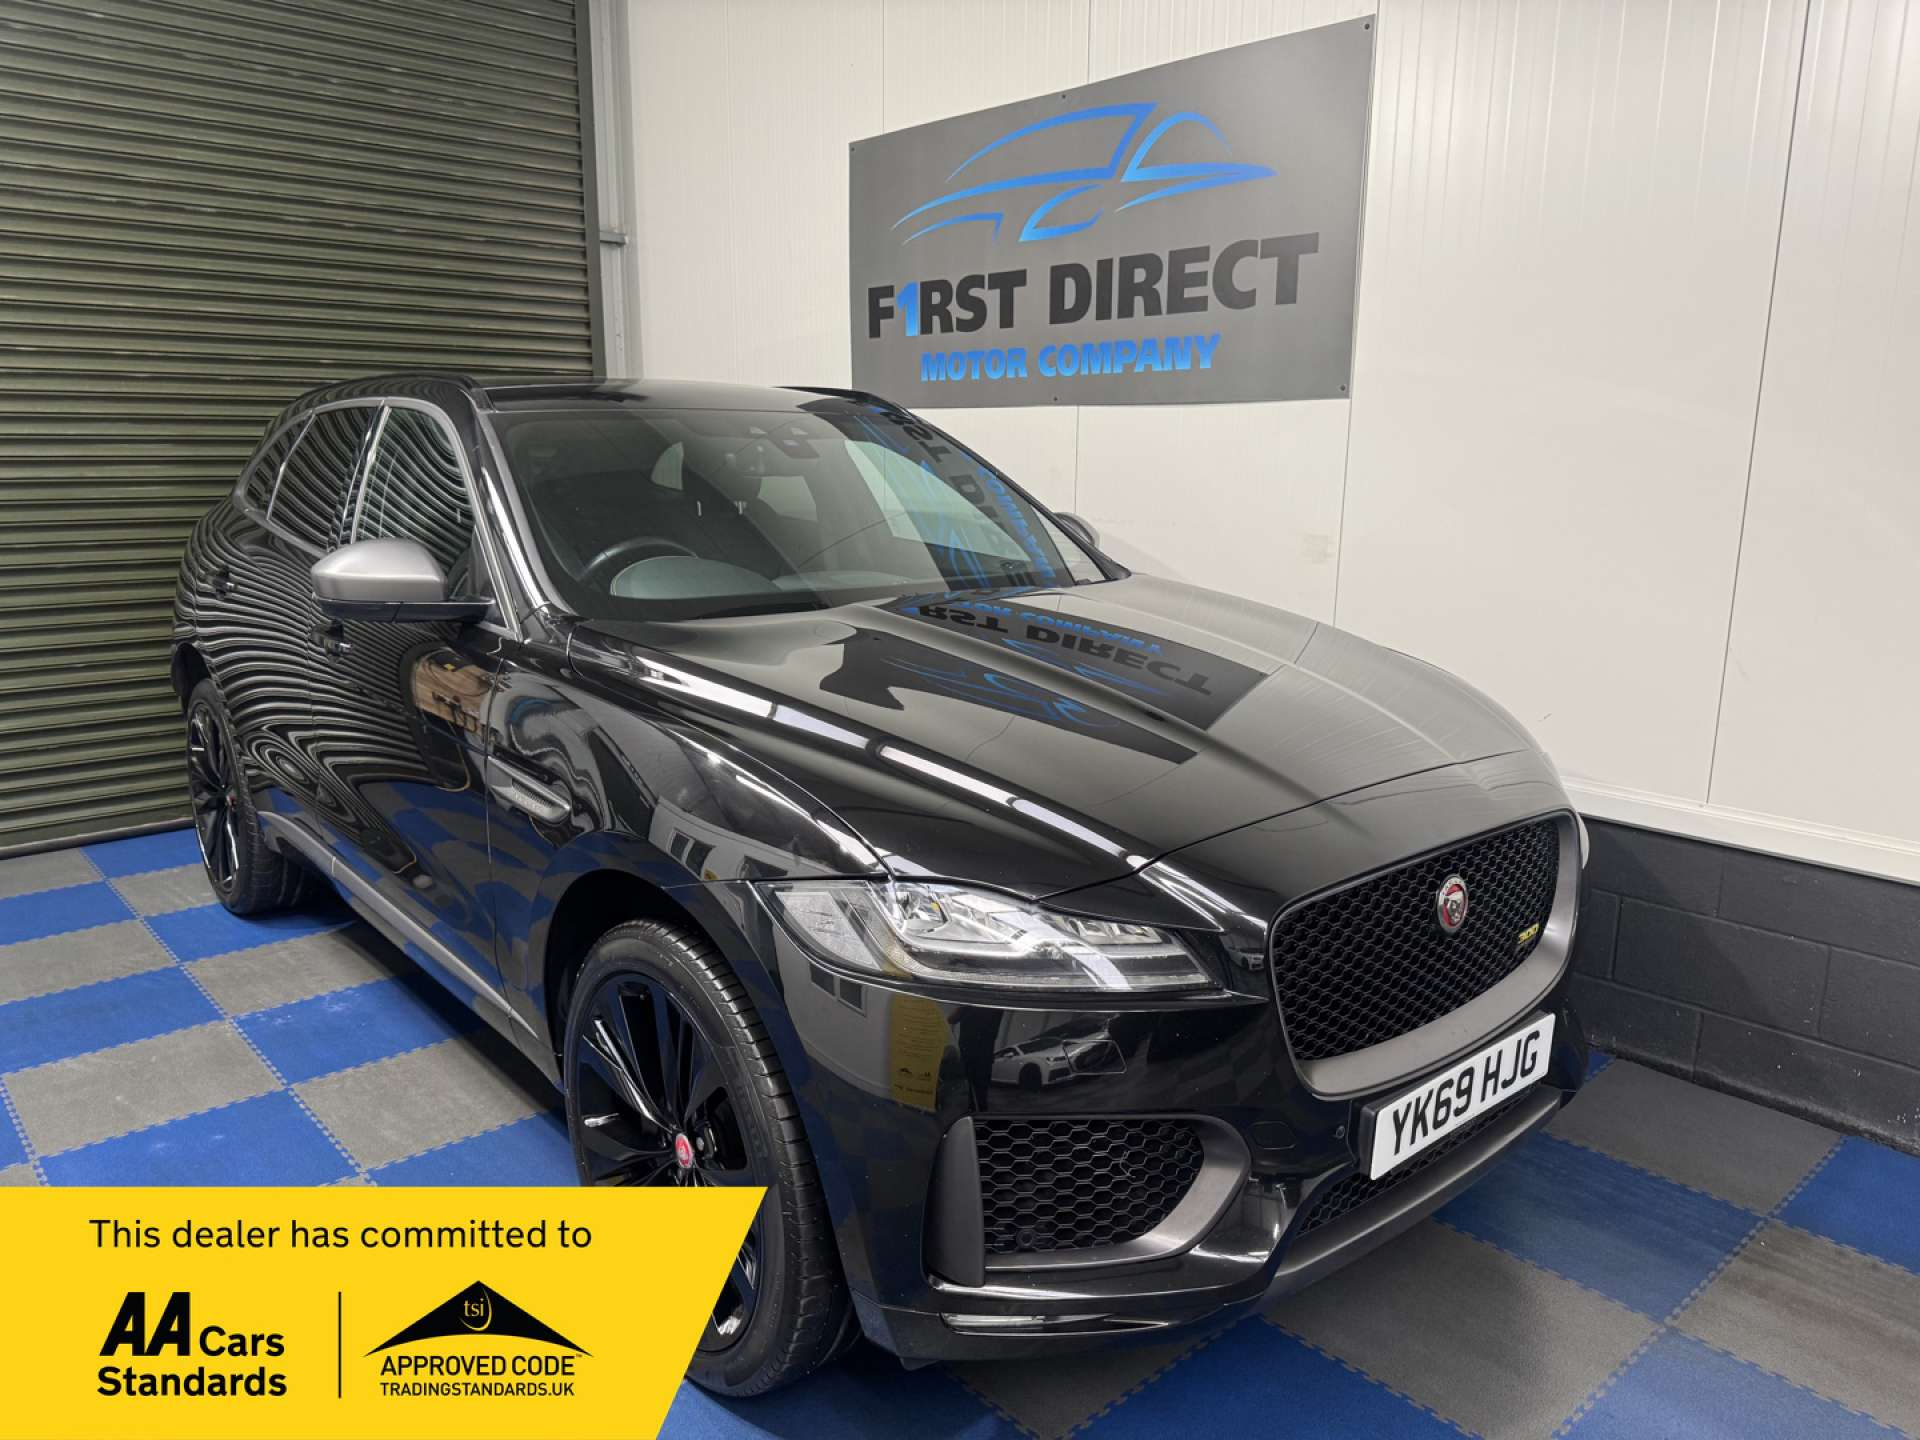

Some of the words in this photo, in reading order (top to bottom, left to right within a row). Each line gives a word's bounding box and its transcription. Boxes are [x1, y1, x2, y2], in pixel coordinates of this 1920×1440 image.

[867, 269, 1027, 339] F1RST
[1048, 232, 1320, 325] DIRECT
[920, 347, 1028, 382] MOTOR
[1038, 332, 1222, 377] COMPANY
[1391, 1068, 1475, 1157] YK69
[1480, 1030, 1541, 1105] HJG
